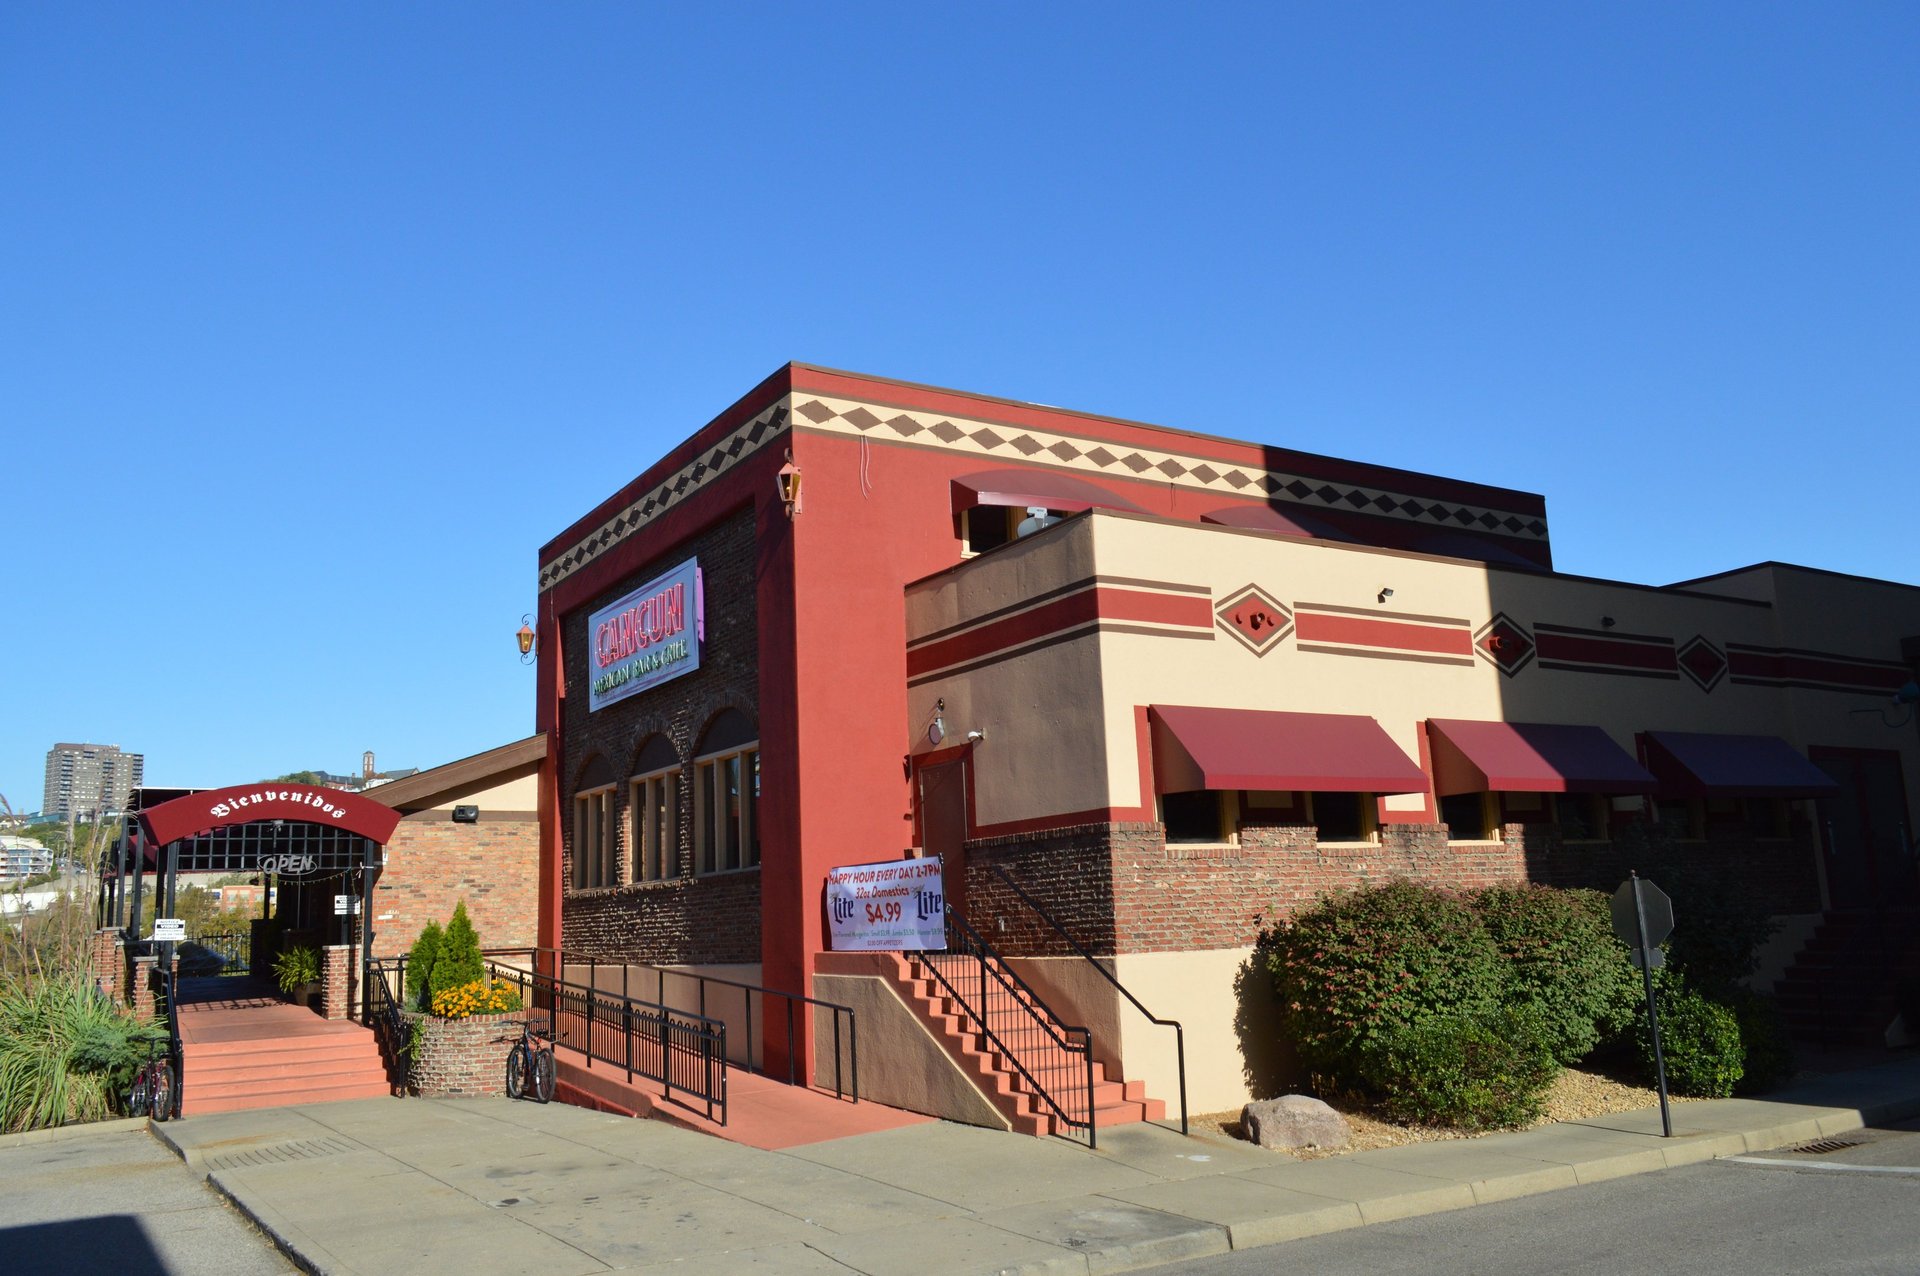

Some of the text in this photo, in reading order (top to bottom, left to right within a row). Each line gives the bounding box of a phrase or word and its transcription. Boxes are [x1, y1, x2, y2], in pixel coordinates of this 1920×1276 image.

[595, 583, 685, 668] CANCUN
[593, 664, 629, 694] MEXICAN
[633, 655, 650, 677] BAR
[210, 790, 346, 818] Bienvenidos
[263, 854, 313, 874] OPEN
[829, 864, 941, 885] HAPPY HOUR EVERY DAY 2-7PM
[855, 884, 909, 899] 32oz Domestics
[832, 897, 854, 924] Lite
[865, 902, 901, 926] $4.99
[916, 891, 942, 921] Lite
